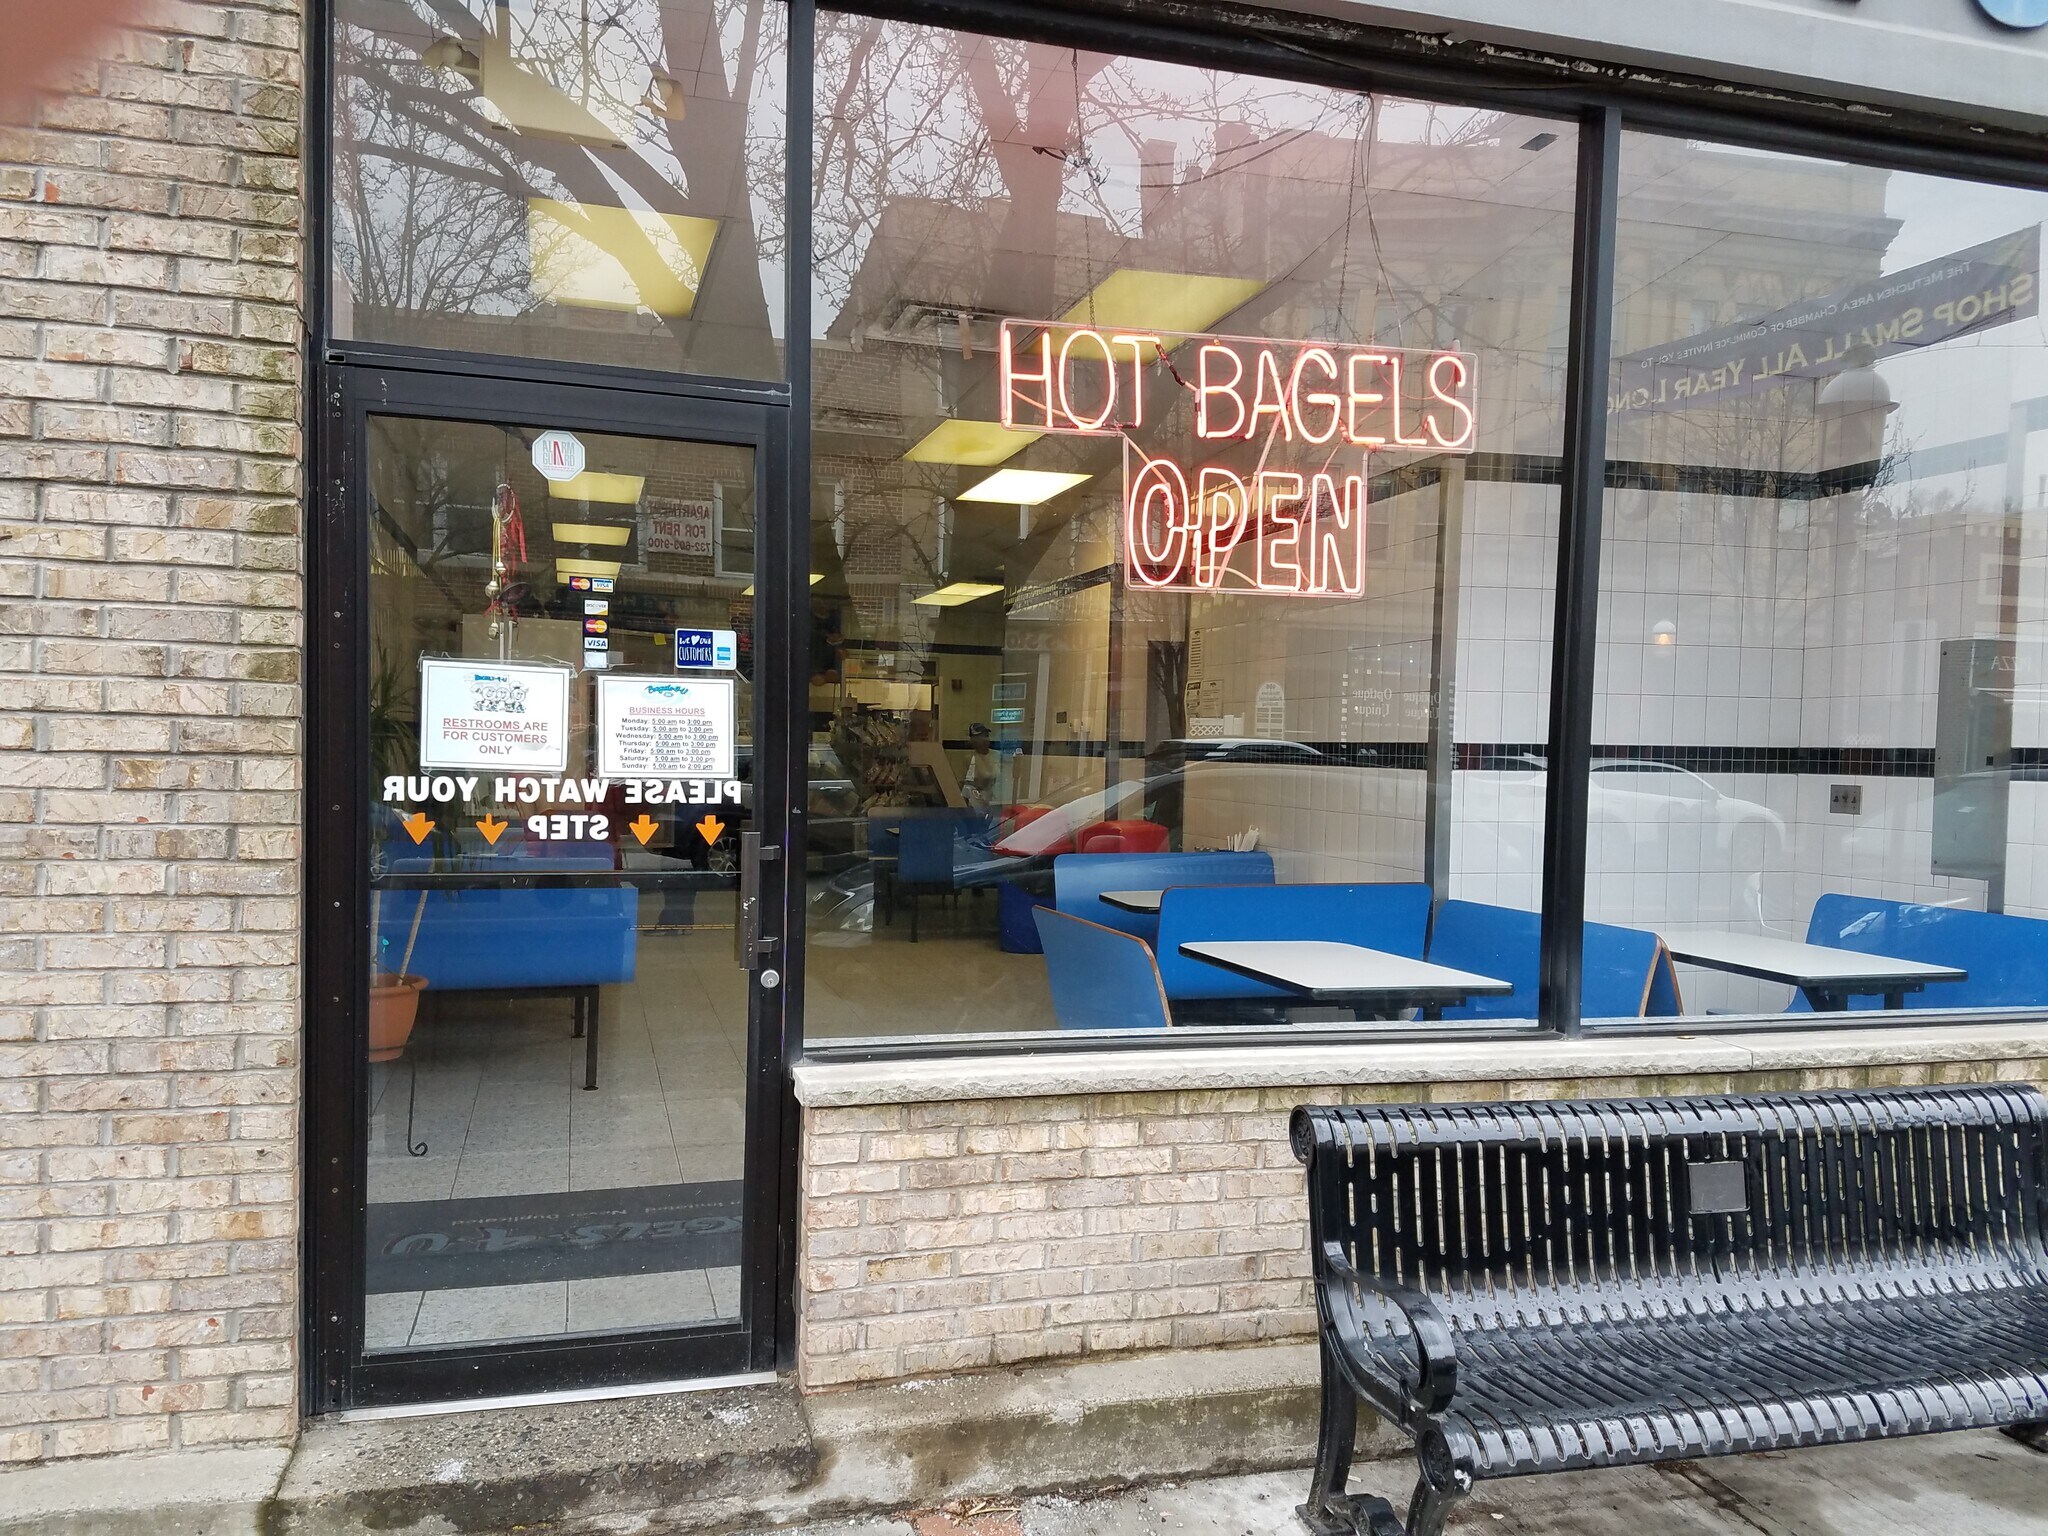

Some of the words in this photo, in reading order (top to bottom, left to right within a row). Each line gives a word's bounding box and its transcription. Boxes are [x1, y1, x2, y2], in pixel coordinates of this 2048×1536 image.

[1003, 328, 1160, 430] HOT
[1197, 344, 1473, 448] BAGELS
[1128, 458, 1364, 594] OPEN
[679, 647, 712, 661] CUSTOMERS
[629, 707, 673, 715] BUSINESS
[675, 708, 705, 716] HOURS
[443, 718, 520, 730] RESTROOMS
[523, 721, 548, 731] ARE
[443, 731, 468, 740] FOR
[472, 732, 548, 744] CUSTOMERS
[479, 745, 513, 755] ONLY
